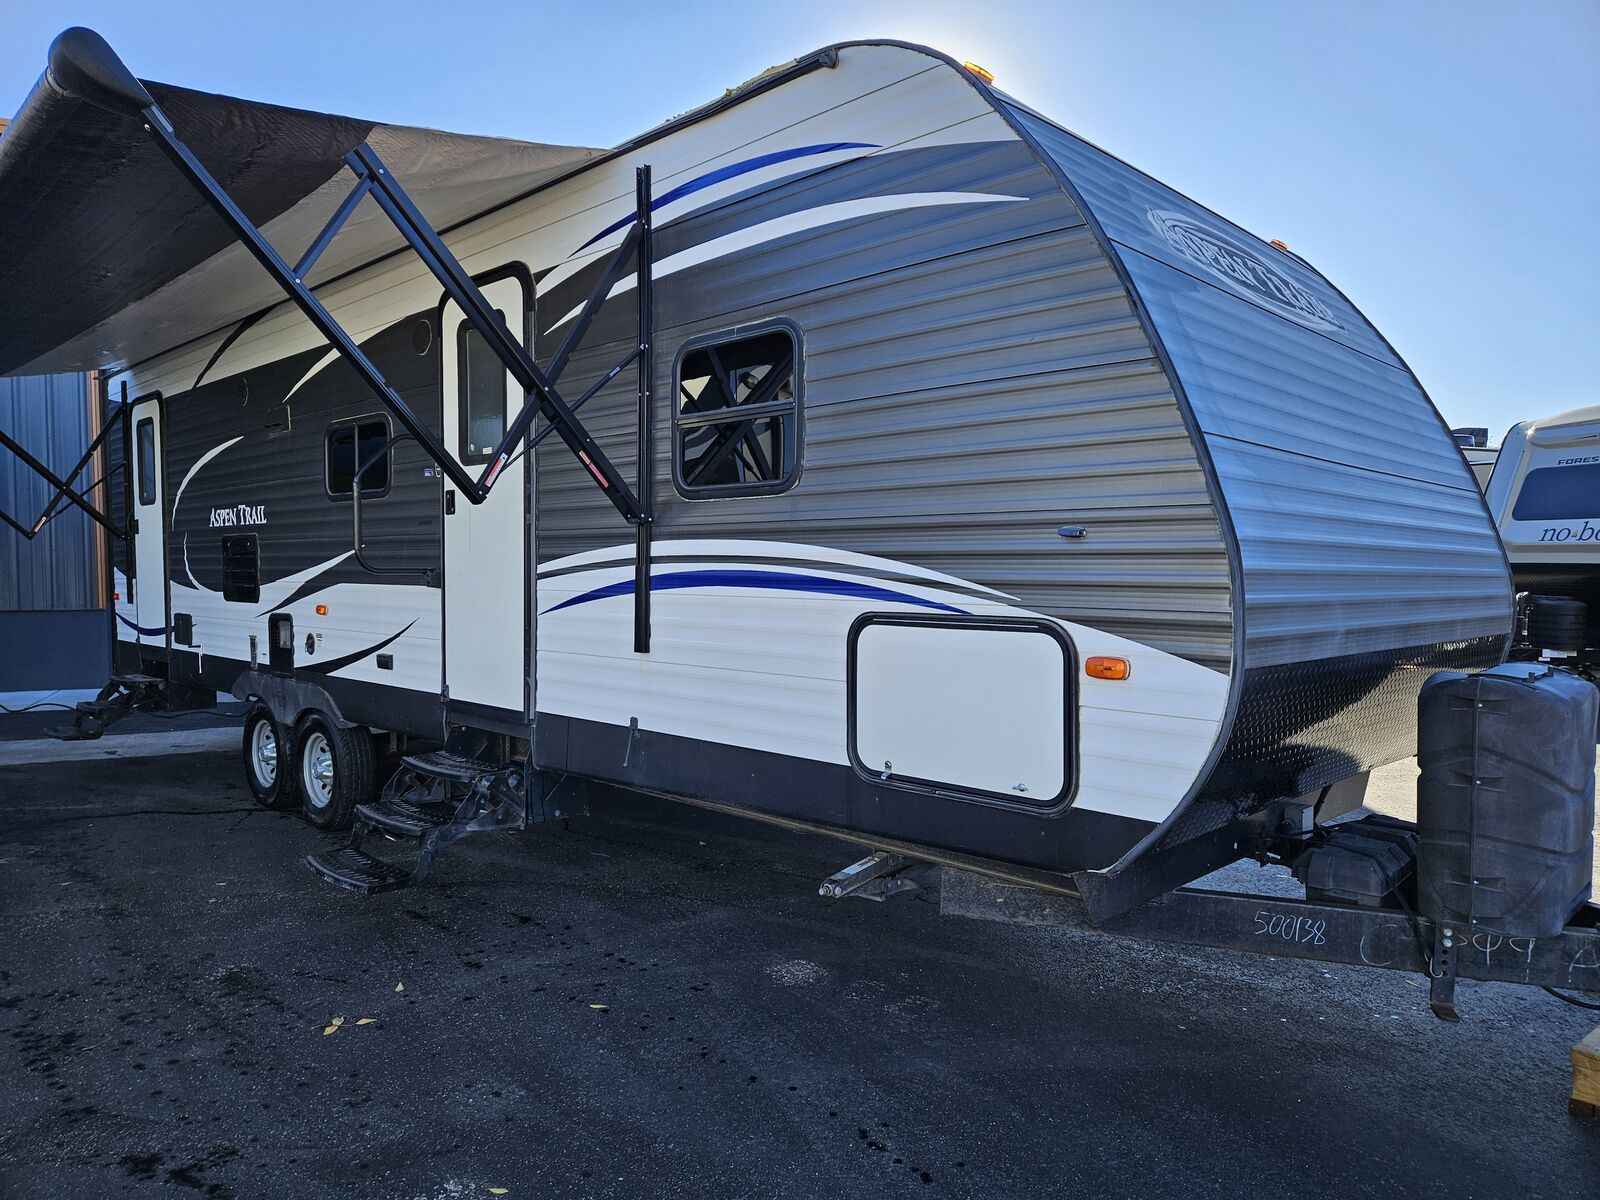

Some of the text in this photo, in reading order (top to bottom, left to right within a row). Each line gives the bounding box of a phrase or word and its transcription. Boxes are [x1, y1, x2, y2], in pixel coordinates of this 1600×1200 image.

[1557, 455, 1600, 466] FORES
[209, 504, 267, 527] ASPEN TRAIL
[1254, 910, 1326, 945] 500138
